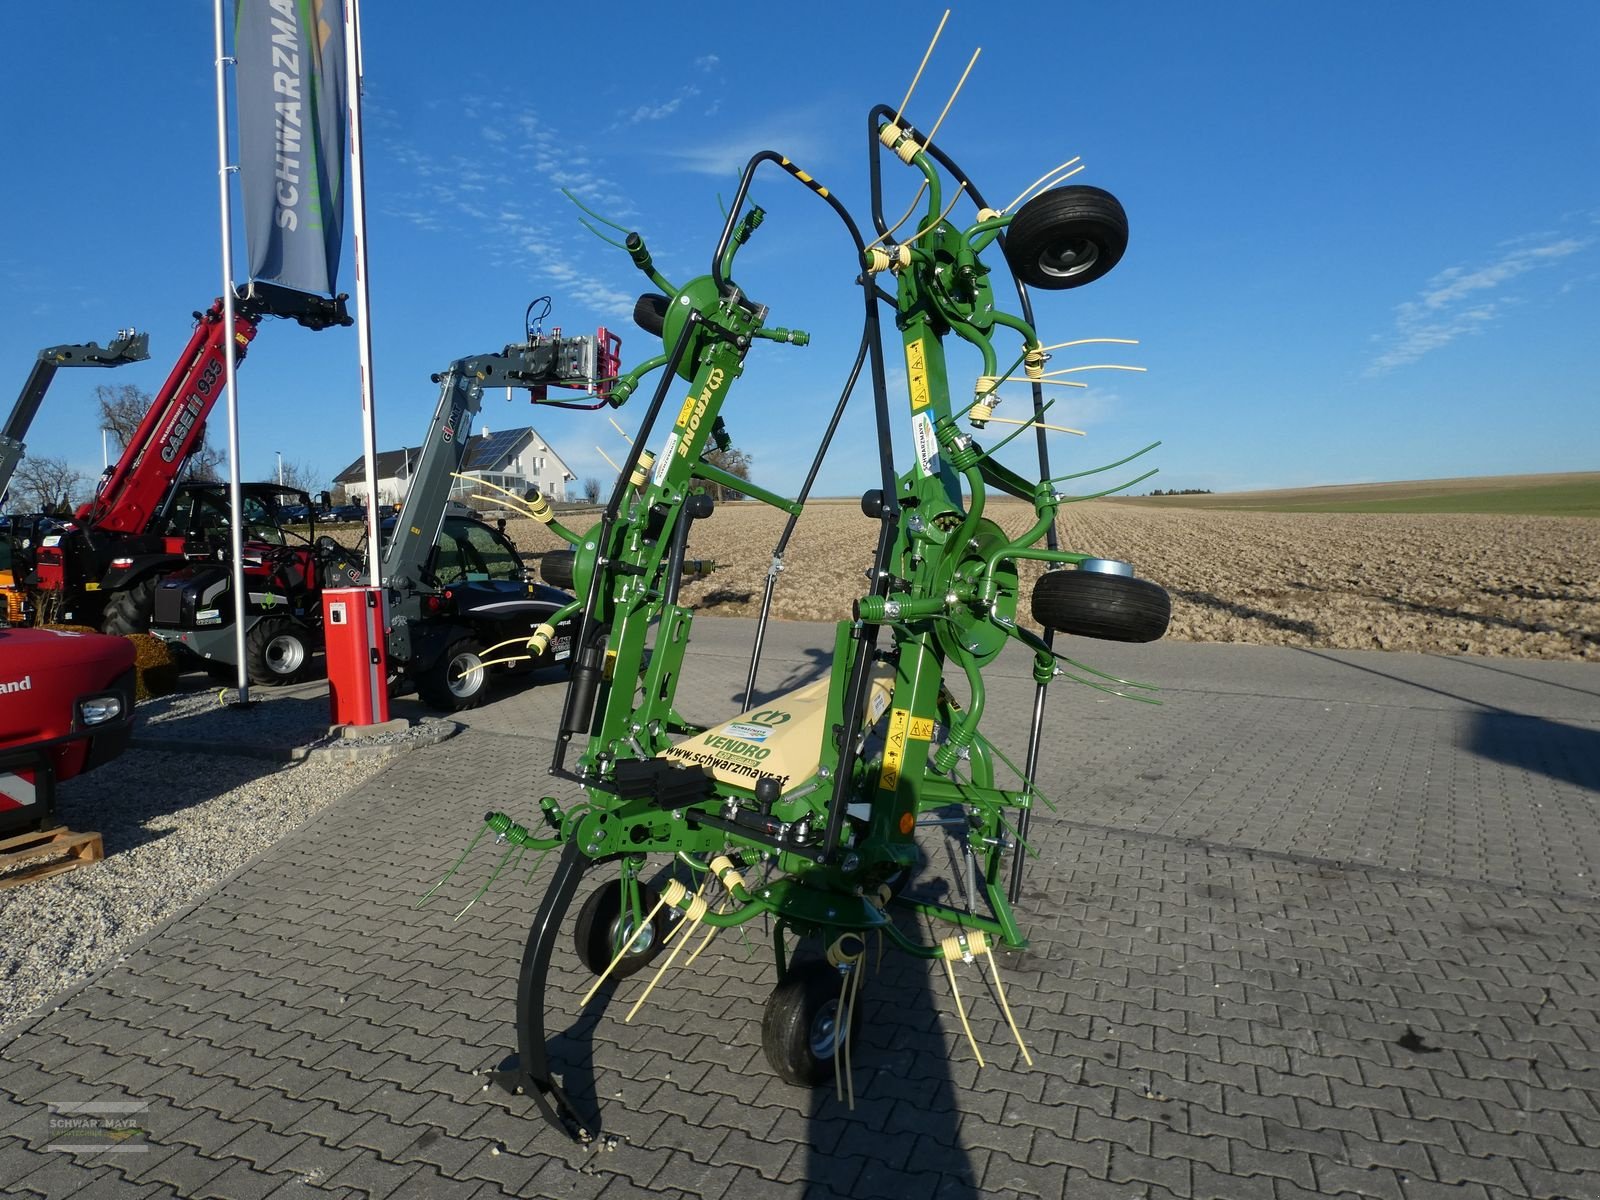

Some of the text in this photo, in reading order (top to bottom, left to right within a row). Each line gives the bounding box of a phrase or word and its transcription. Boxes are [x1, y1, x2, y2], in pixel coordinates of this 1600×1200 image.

[196, 358, 224, 396] 935
[677, 387, 713, 459] KRONE
[665, 746, 791, 787] www.schwarzmayrat
[703, 734, 772, 760] VENDRO
